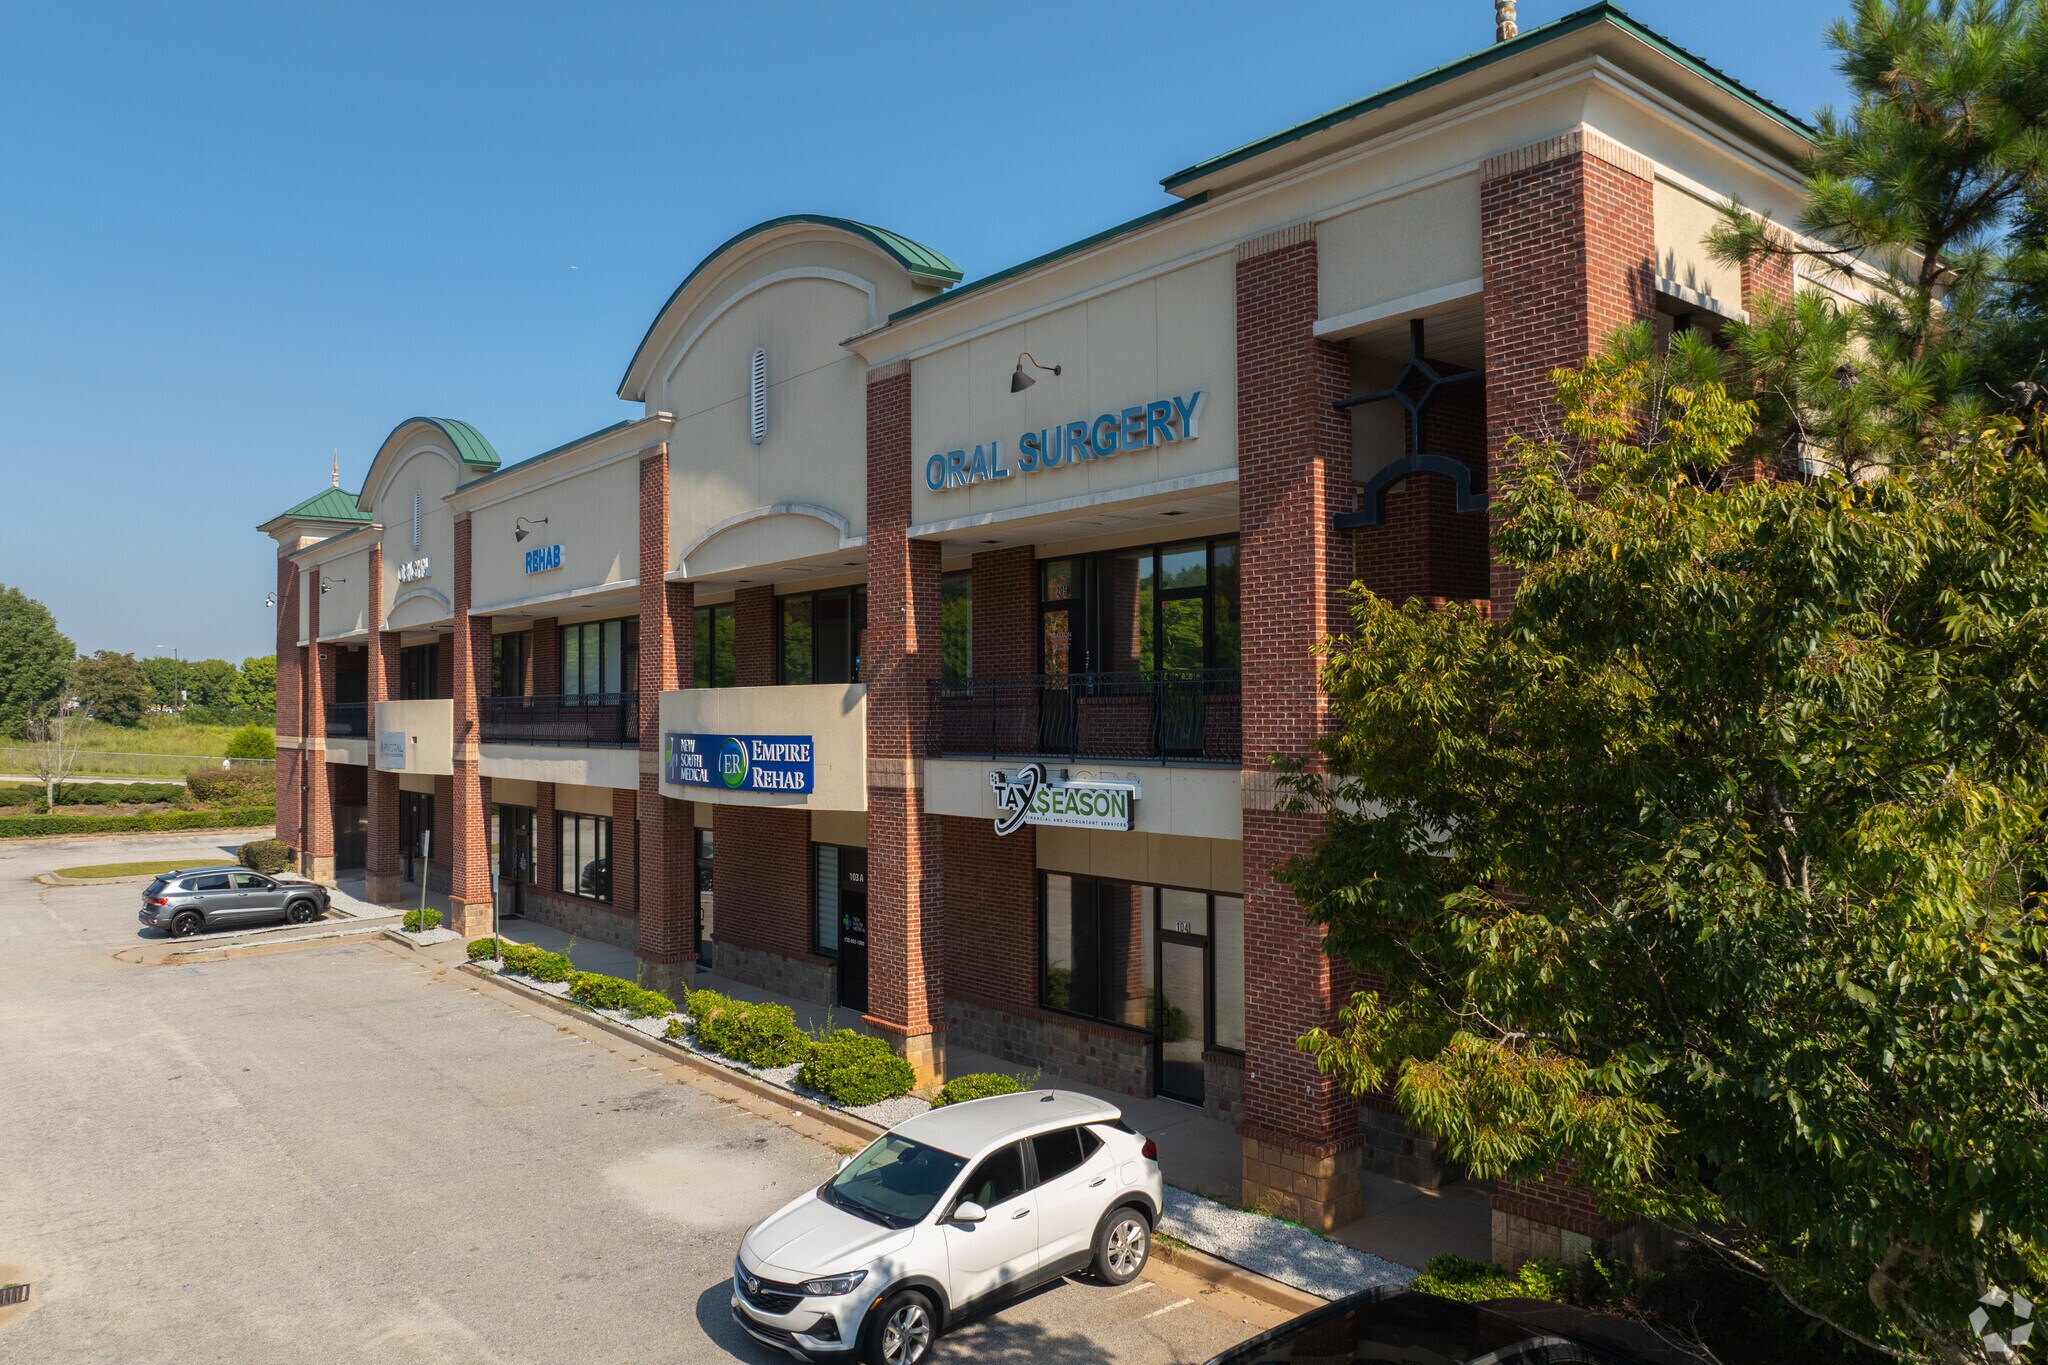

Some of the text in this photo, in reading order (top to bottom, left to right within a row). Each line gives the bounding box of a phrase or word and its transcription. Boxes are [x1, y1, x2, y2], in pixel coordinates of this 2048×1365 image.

[926, 391, 1206, 491] ORAL SURGERY
[525, 544, 563, 574] REHAB
[680, 739, 695, 753] NEW
[752, 740, 810, 762] EMPIRE
[680, 754, 702, 767] SOUTH
[724, 754, 741, 774] ER
[680, 769, 709, 782] MEDICAL
[752, 767, 805, 789] REHAB
[1065, 818, 1099, 826] ACCOUNTANT
